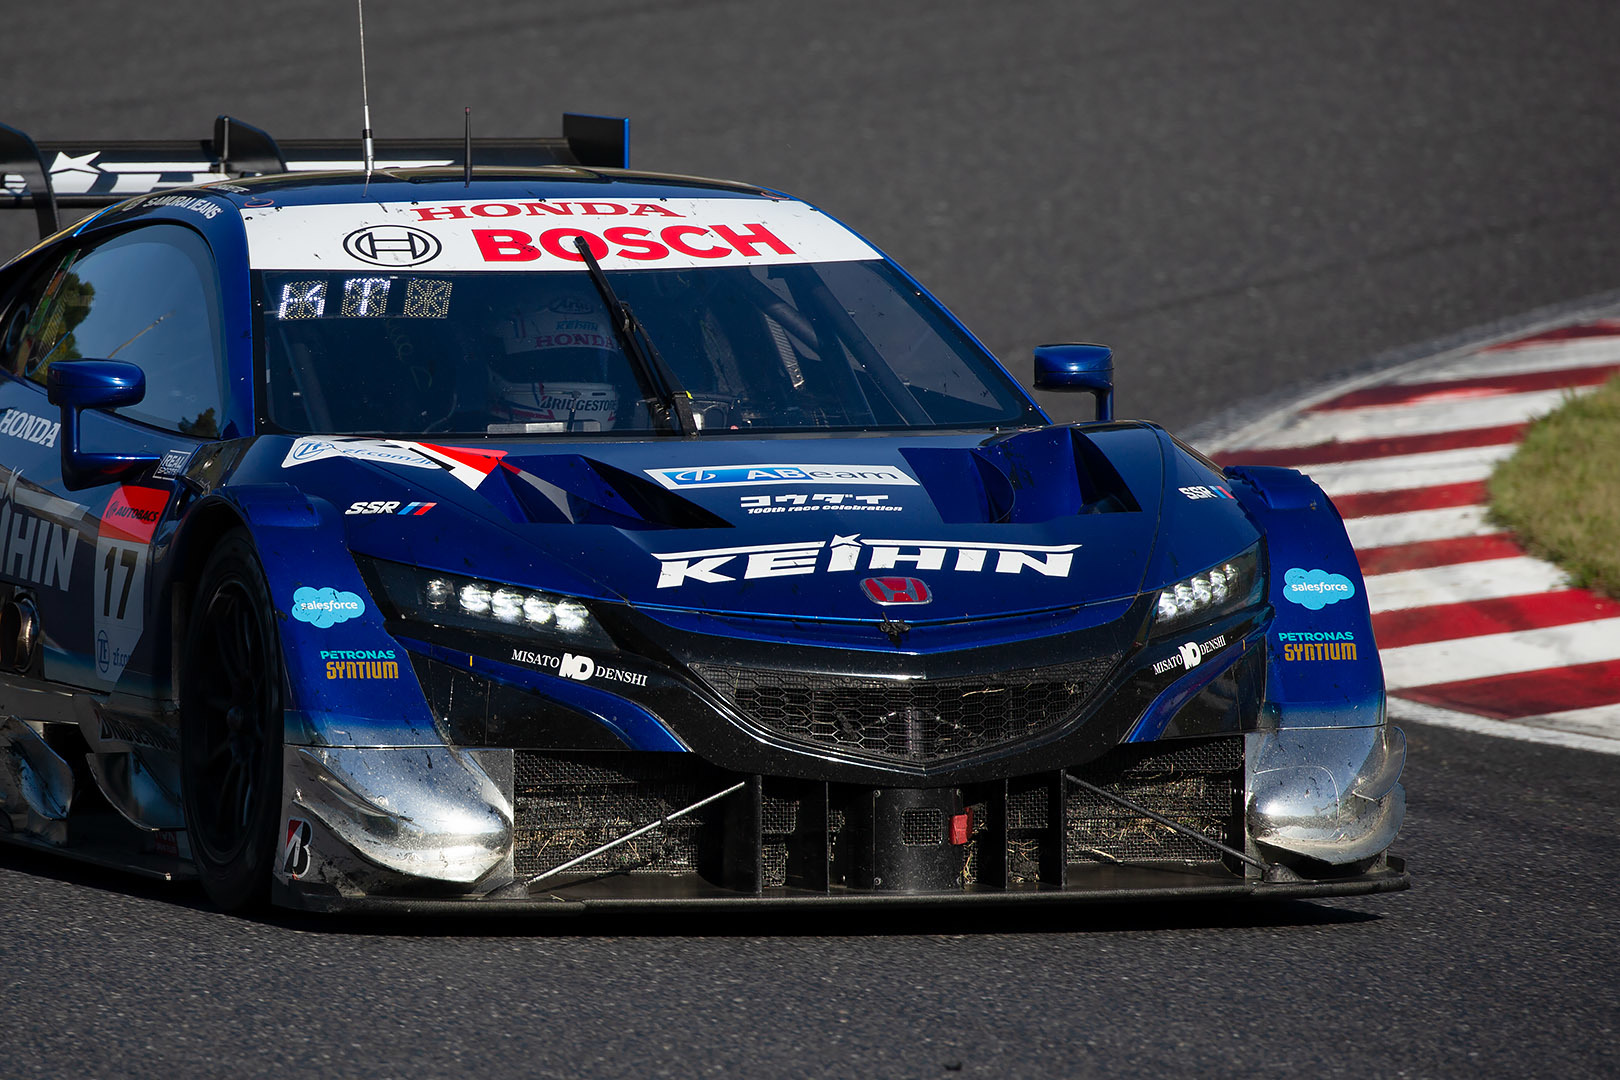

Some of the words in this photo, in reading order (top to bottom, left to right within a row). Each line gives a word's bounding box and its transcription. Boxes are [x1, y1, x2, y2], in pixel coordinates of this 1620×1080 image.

[416, 202, 687, 222] HONDA
[470, 223, 797, 263] BOSCH
[534, 333, 615, 348] HONDA
[0, 409, 61, 448] HONDA
[745, 466, 899, 482] ABeam
[1178, 485, 1218, 500] SSR
[115, 505, 159, 523] AUTOBACS
[344, 501, 401, 515] SSR
[748, 506, 786, 515] 100th
[788, 505, 820, 513] race
[822, 504, 903, 512] celebration
[652, 533, 1081, 589] KEIHIN
[104, 546, 139, 620] 17
[1291, 582, 1348, 593] salesforce
[300, 598, 358, 612] salesforce
[1278, 631, 1354, 642] PETRONAS
[320, 650, 396, 660] PETRONAS
[1152, 654, 1183, 675] MISATO
[1200, 635, 1226, 655] DENSHI
[511, 649, 560, 669] MISATO
[595, 666, 648, 687] DENSHI
